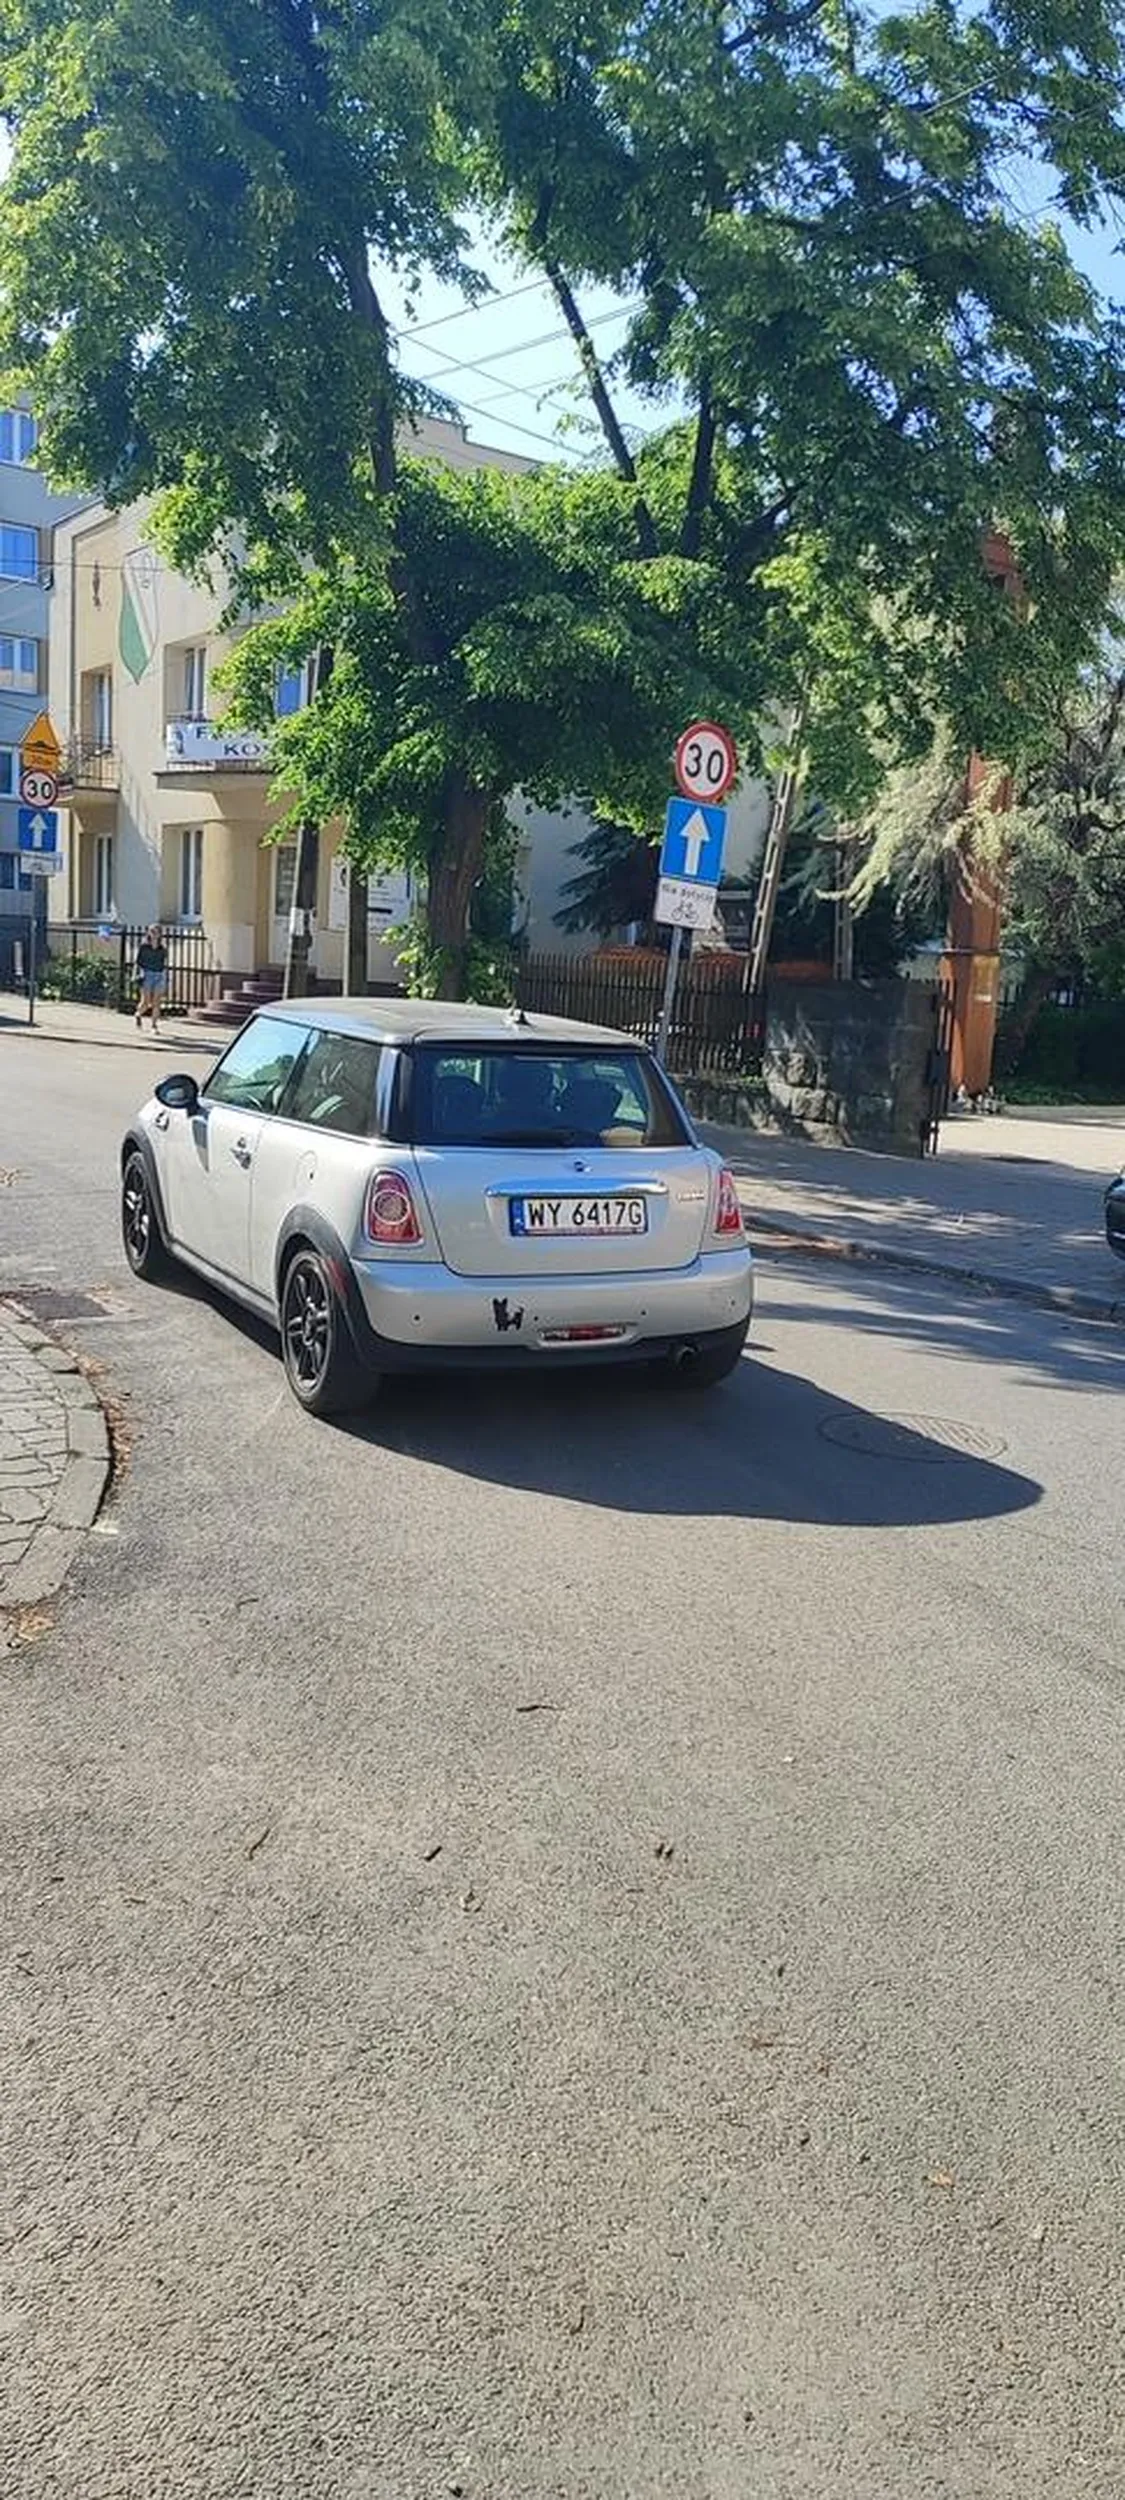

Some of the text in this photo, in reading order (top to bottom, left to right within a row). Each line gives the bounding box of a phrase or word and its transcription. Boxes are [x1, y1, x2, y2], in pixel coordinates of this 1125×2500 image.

[685, 743, 724, 784] 30
[27, 779, 53, 799] 30
[528, 1202, 643, 1226] WY 6417G
